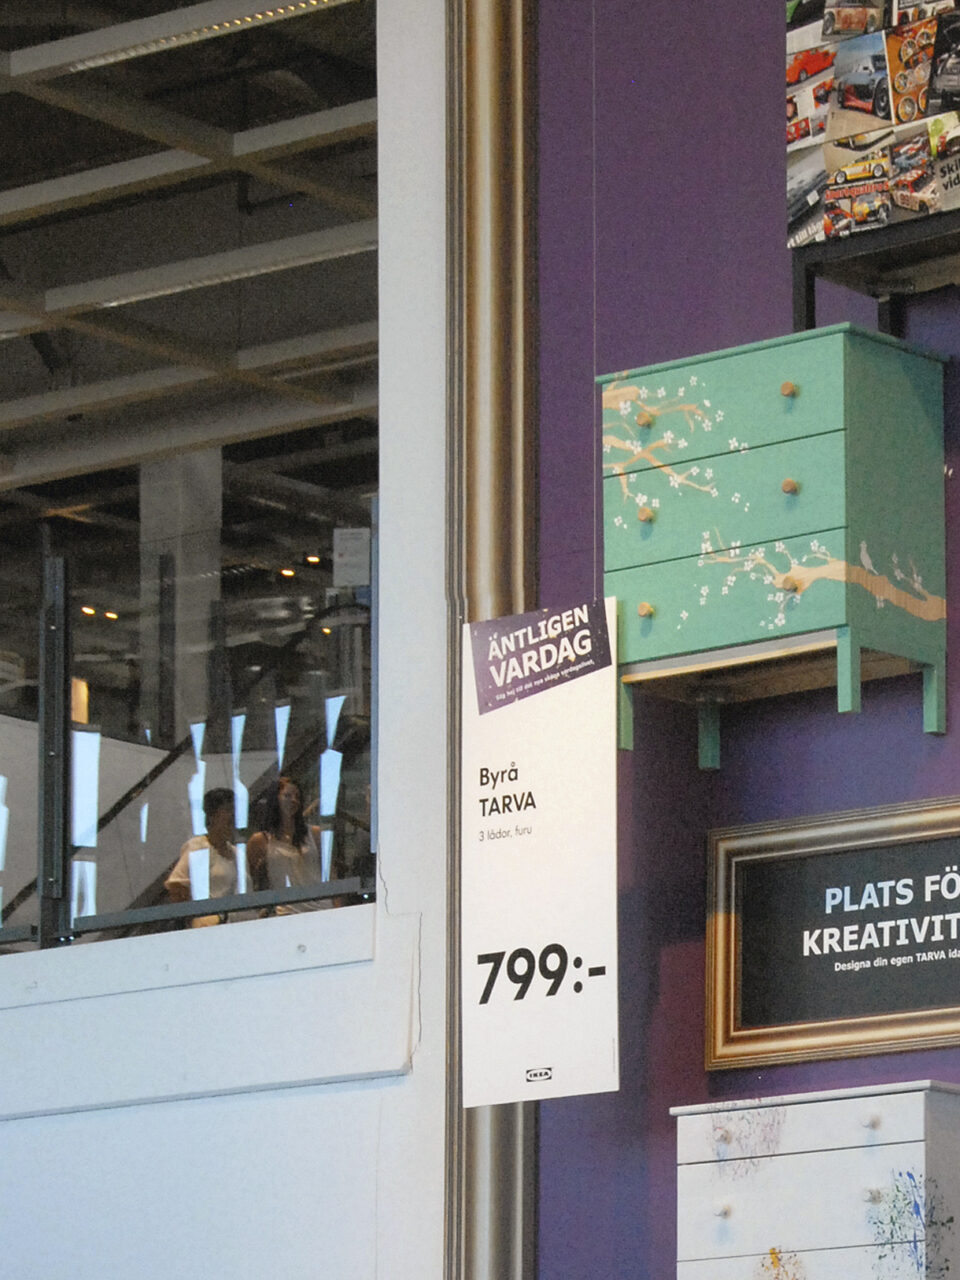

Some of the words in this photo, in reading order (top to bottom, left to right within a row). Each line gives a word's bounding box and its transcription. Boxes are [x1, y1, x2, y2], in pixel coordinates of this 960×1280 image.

[942, 174, 960, 190] vid
[488, 604, 589, 661] ÄNTLIGEN
[489, 629, 592, 687] VARDAG
[480, 761, 518, 790] Byrå
[479, 791, 537, 817] TARVA
[479, 831, 485, 841] 3
[515, 825, 533, 836] furu
[825, 878, 914, 914] PLATS
[477, 943, 606, 1005] 799:-
[834, 959, 871, 972] Designa
[873, 957, 888, 967] din
[890, 954, 914, 967] egen
[915, 951, 946, 962] TARVA
[527, 1069, 551, 1080] IKEA
